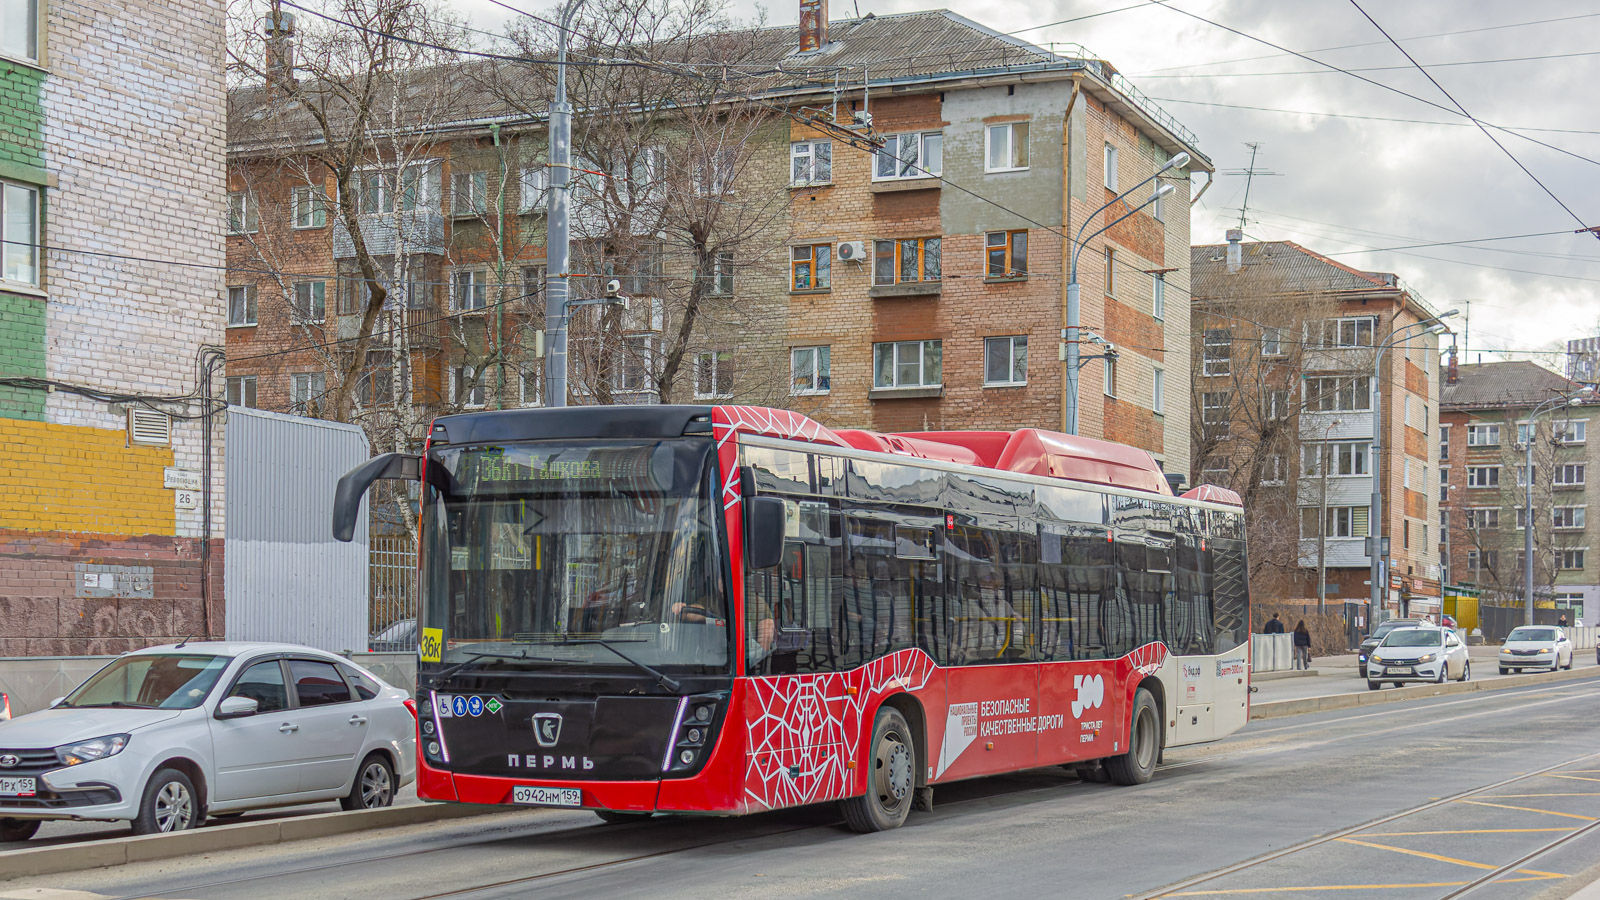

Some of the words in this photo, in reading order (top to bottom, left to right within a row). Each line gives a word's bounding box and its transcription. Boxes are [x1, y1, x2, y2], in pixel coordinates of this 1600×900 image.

[179, 493, 191, 504] 26
[981, 698, 1030, 717] БЕЗОПАСНЫЕ
[980, 716, 1037, 737] КАЧЕСТВЕННЫЕ
[1037, 714, 1064, 734] ДОРОГИ
[508, 754, 594, 770] ПЕРМЬ
[18, 778, 33, 788] 159
[561, 790, 578, 800] 159
